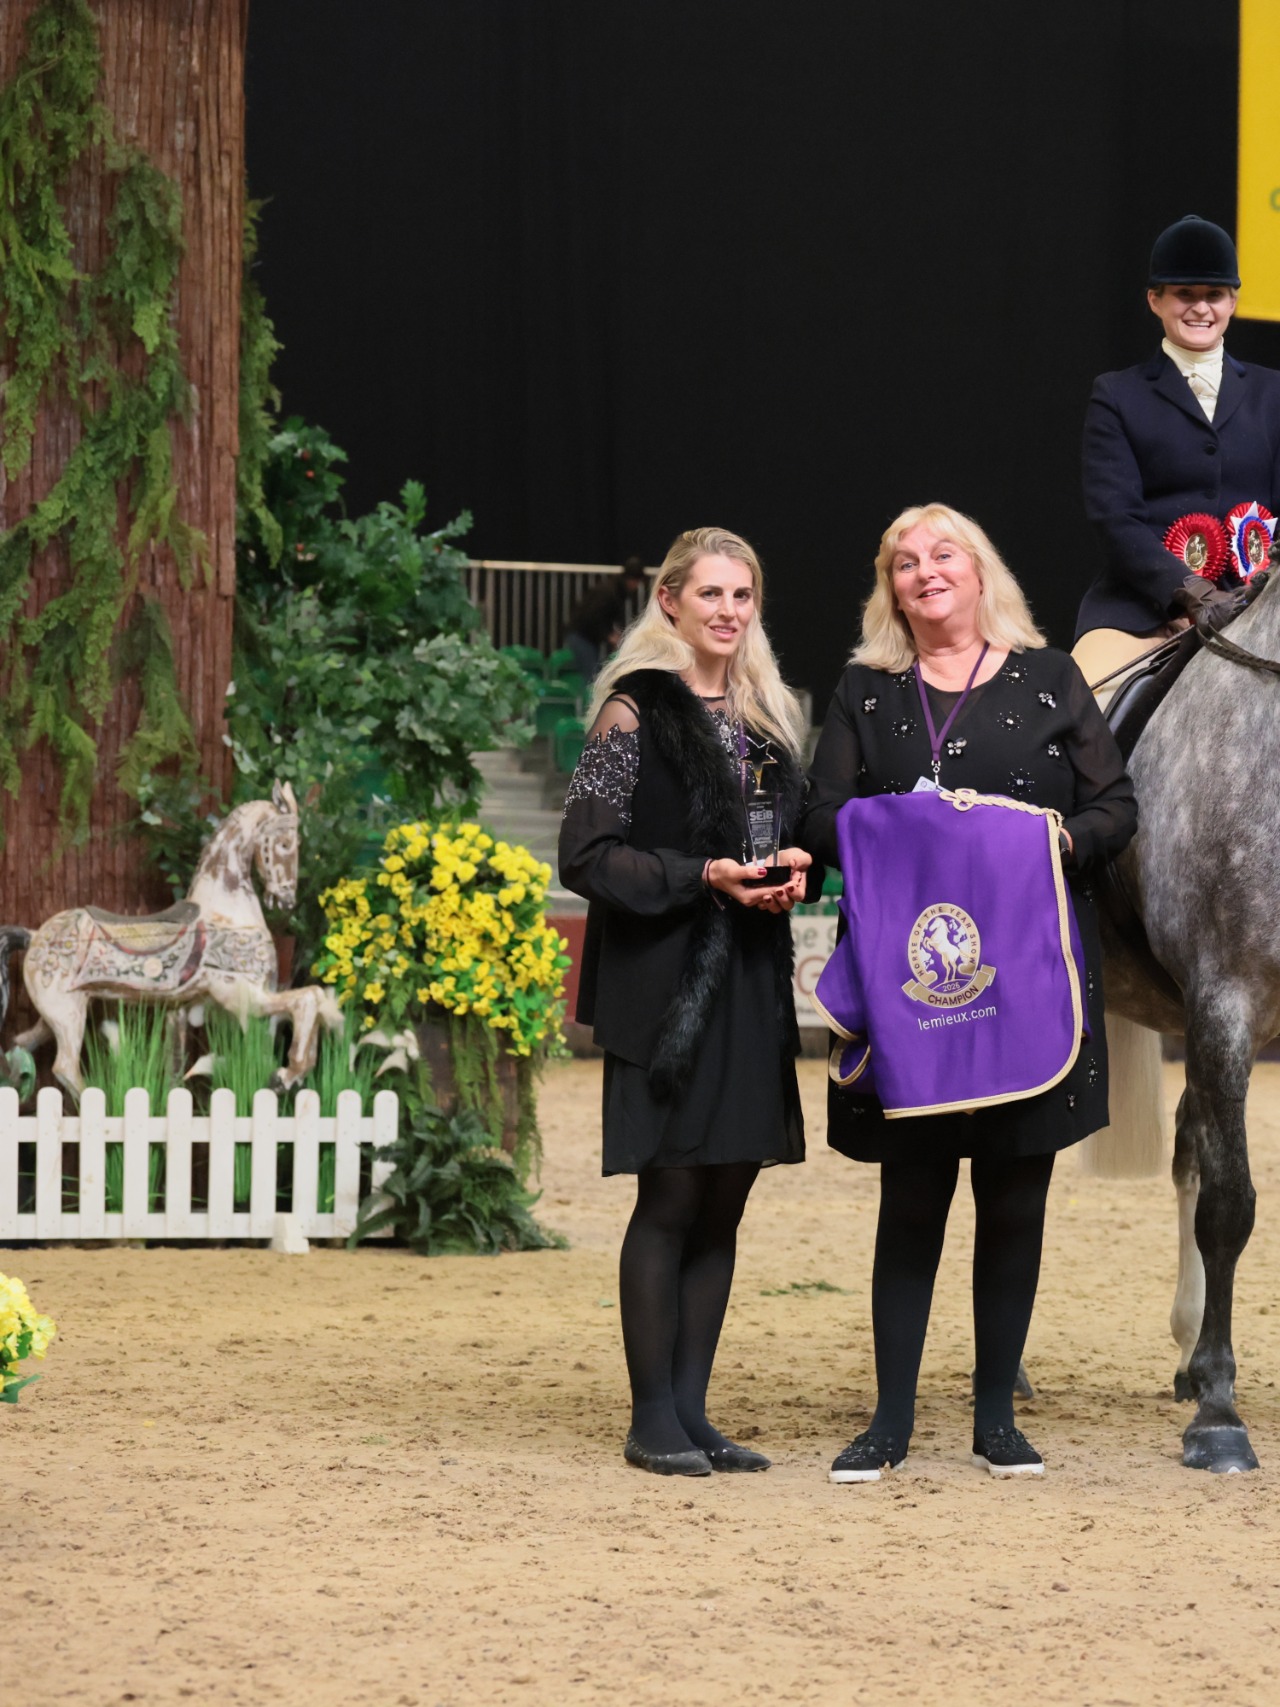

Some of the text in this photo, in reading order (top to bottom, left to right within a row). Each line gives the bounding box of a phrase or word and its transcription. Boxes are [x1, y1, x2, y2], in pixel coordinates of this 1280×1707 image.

[911, 906, 977, 977] HORSE OF THE YEAR SHOW
[928, 985, 979, 1006] CHAMPION
[918, 1006, 997, 1031] lemieux.com
